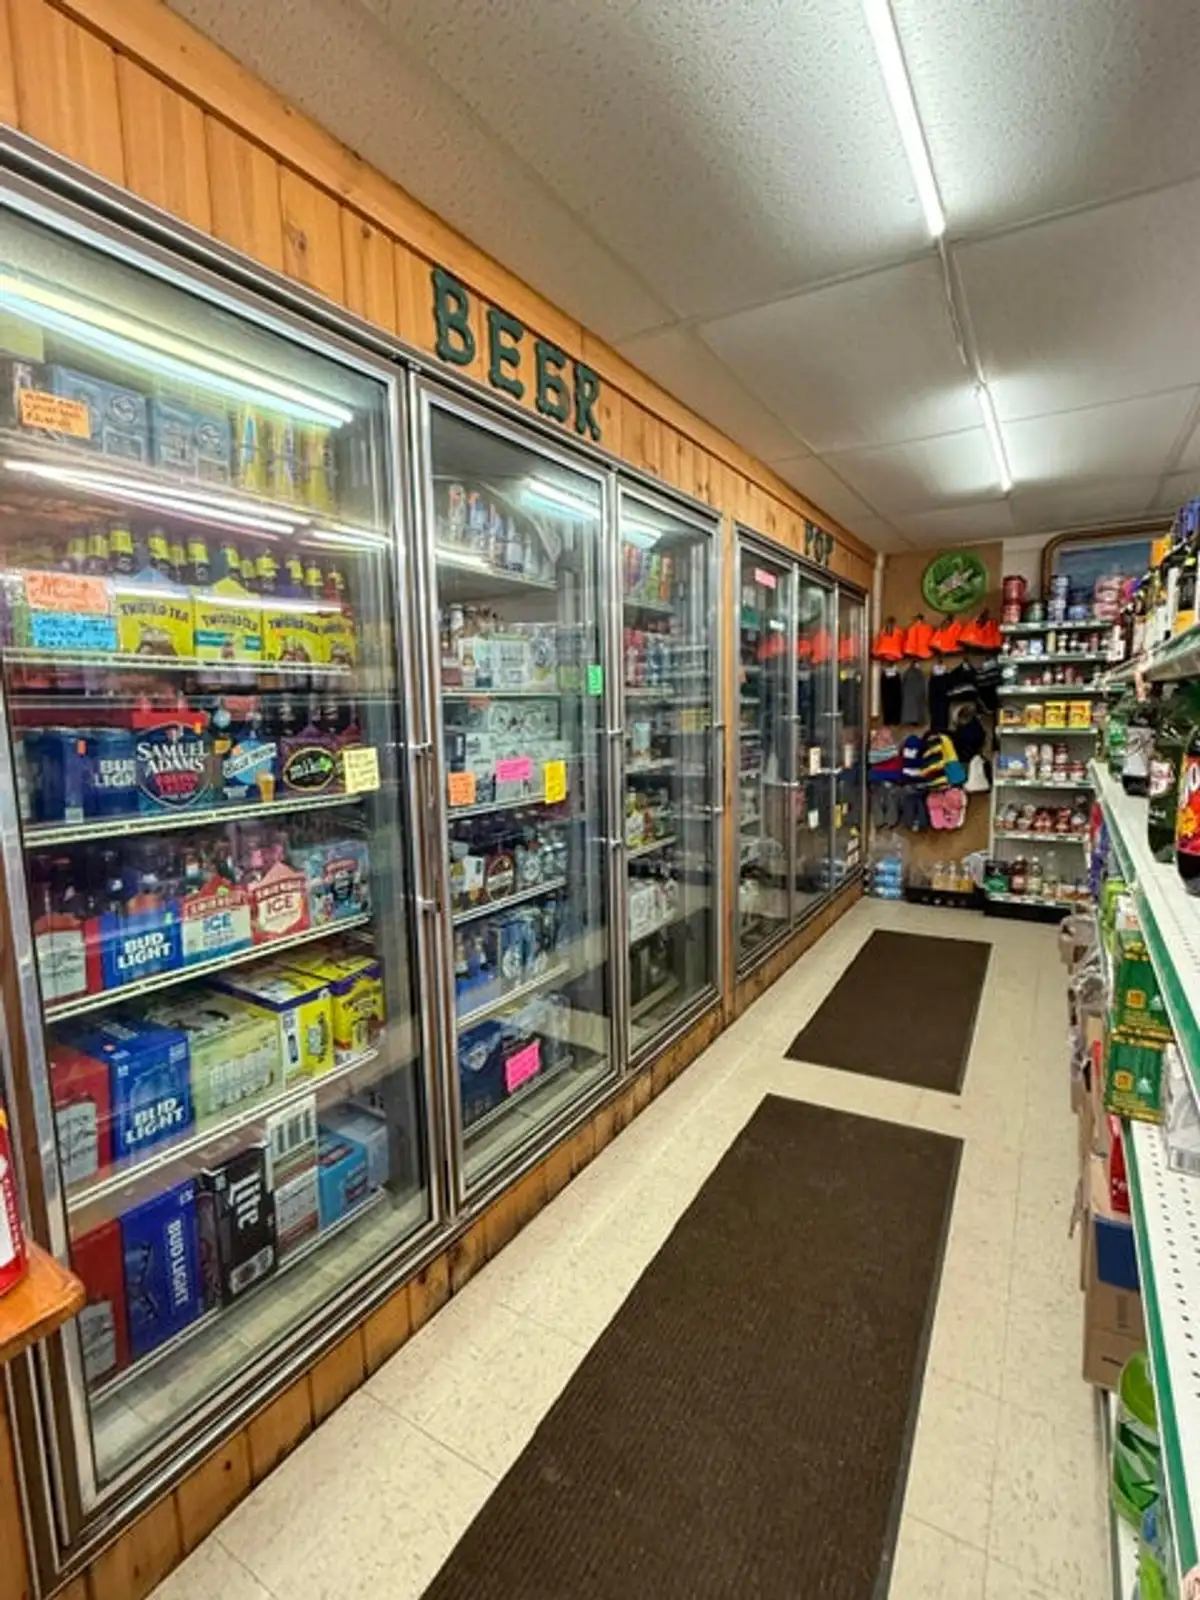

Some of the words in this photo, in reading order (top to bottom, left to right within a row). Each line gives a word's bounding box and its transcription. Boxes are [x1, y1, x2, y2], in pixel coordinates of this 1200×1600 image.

[431, 267, 601, 441] BEER
[137, 741, 209, 761] SAMUEL
[144, 758, 205, 778] ADAMS
[267, 895, 293, 916] ICE
[203, 913, 232, 933] ICE
[117, 942, 172, 969] LIGHT
[124, 931, 164, 955] BUD
[125, 1105, 184, 1144] LIGHT
[134, 1097, 177, 1126] BUD
[167, 1219, 184, 1257] BUD
[171, 1256, 189, 1306] LIGHT
